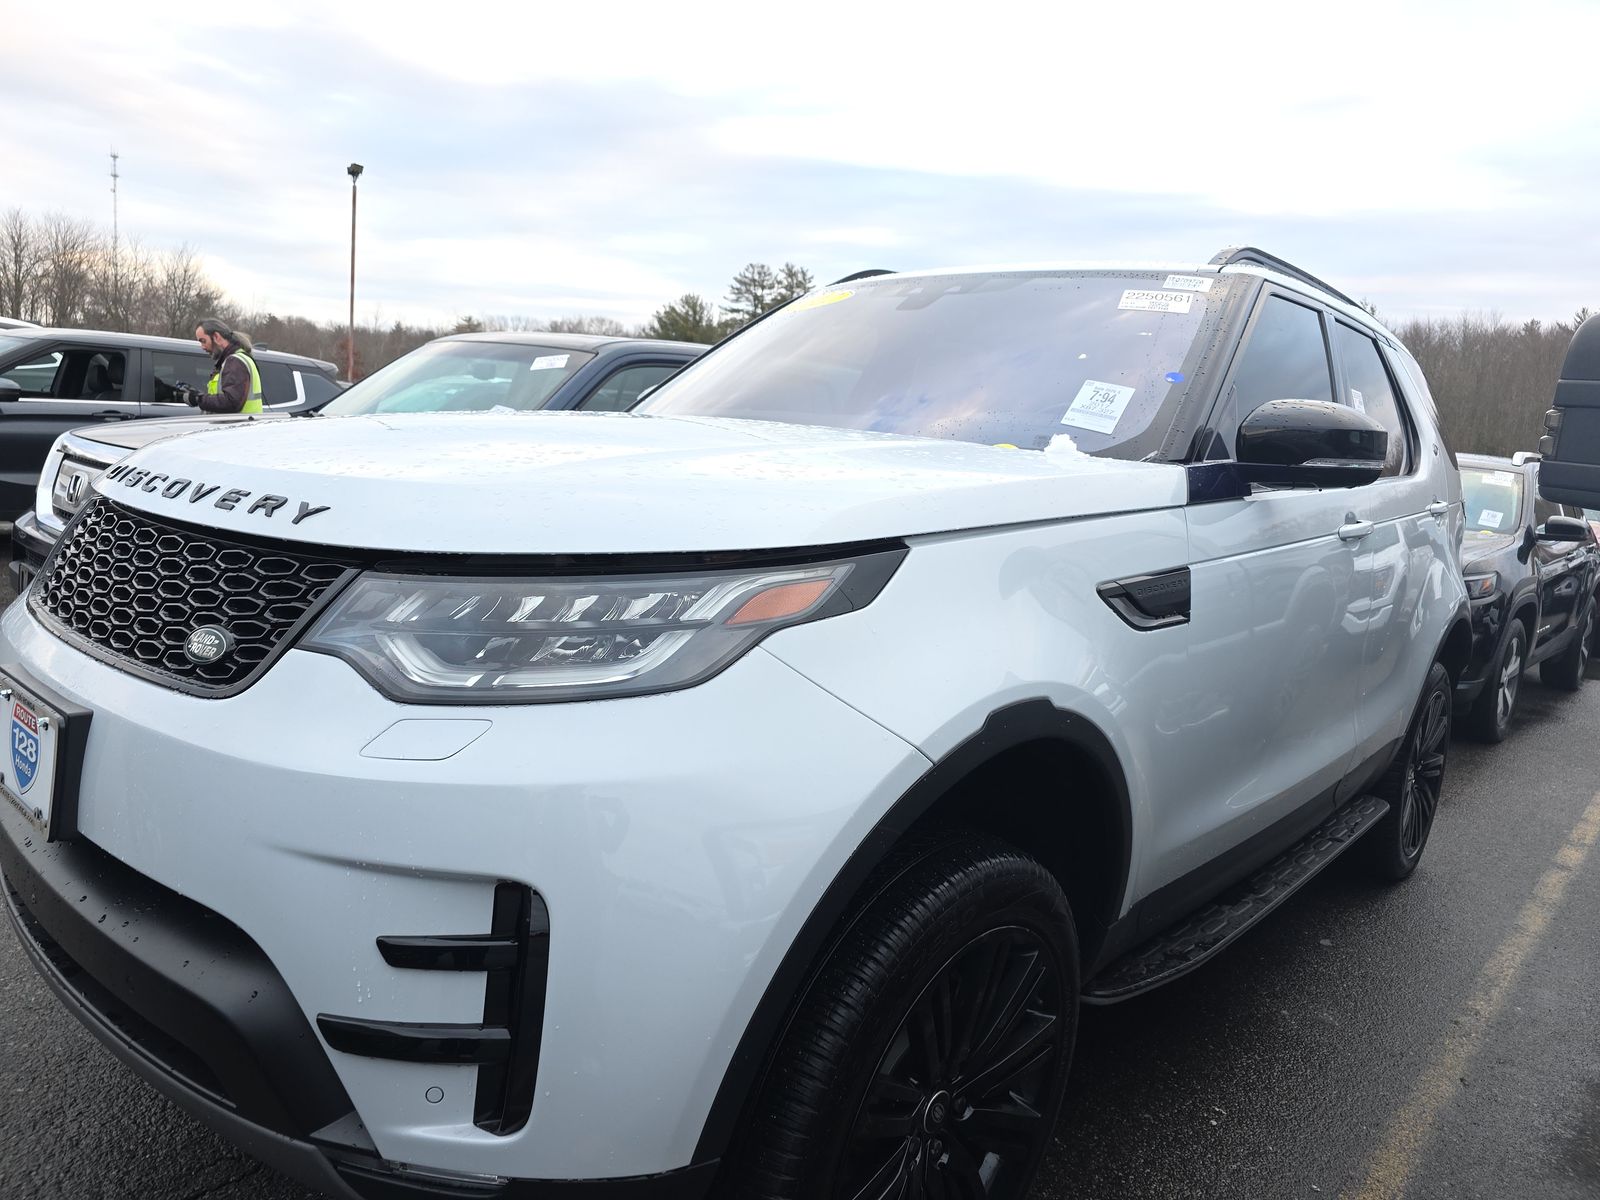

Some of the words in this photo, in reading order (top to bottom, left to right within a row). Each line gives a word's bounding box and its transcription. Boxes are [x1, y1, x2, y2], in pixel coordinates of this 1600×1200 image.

[1125, 291, 1191, 304] 2250561
[106, 465, 331, 525] DISCOVERY
[190, 643, 217, 657] ROVER
[194, 632, 215, 645] LAND
[16, 706, 36, 730] ROUTE
[13, 727, 37, 763] 128
[15, 754, 32, 778] Honda
